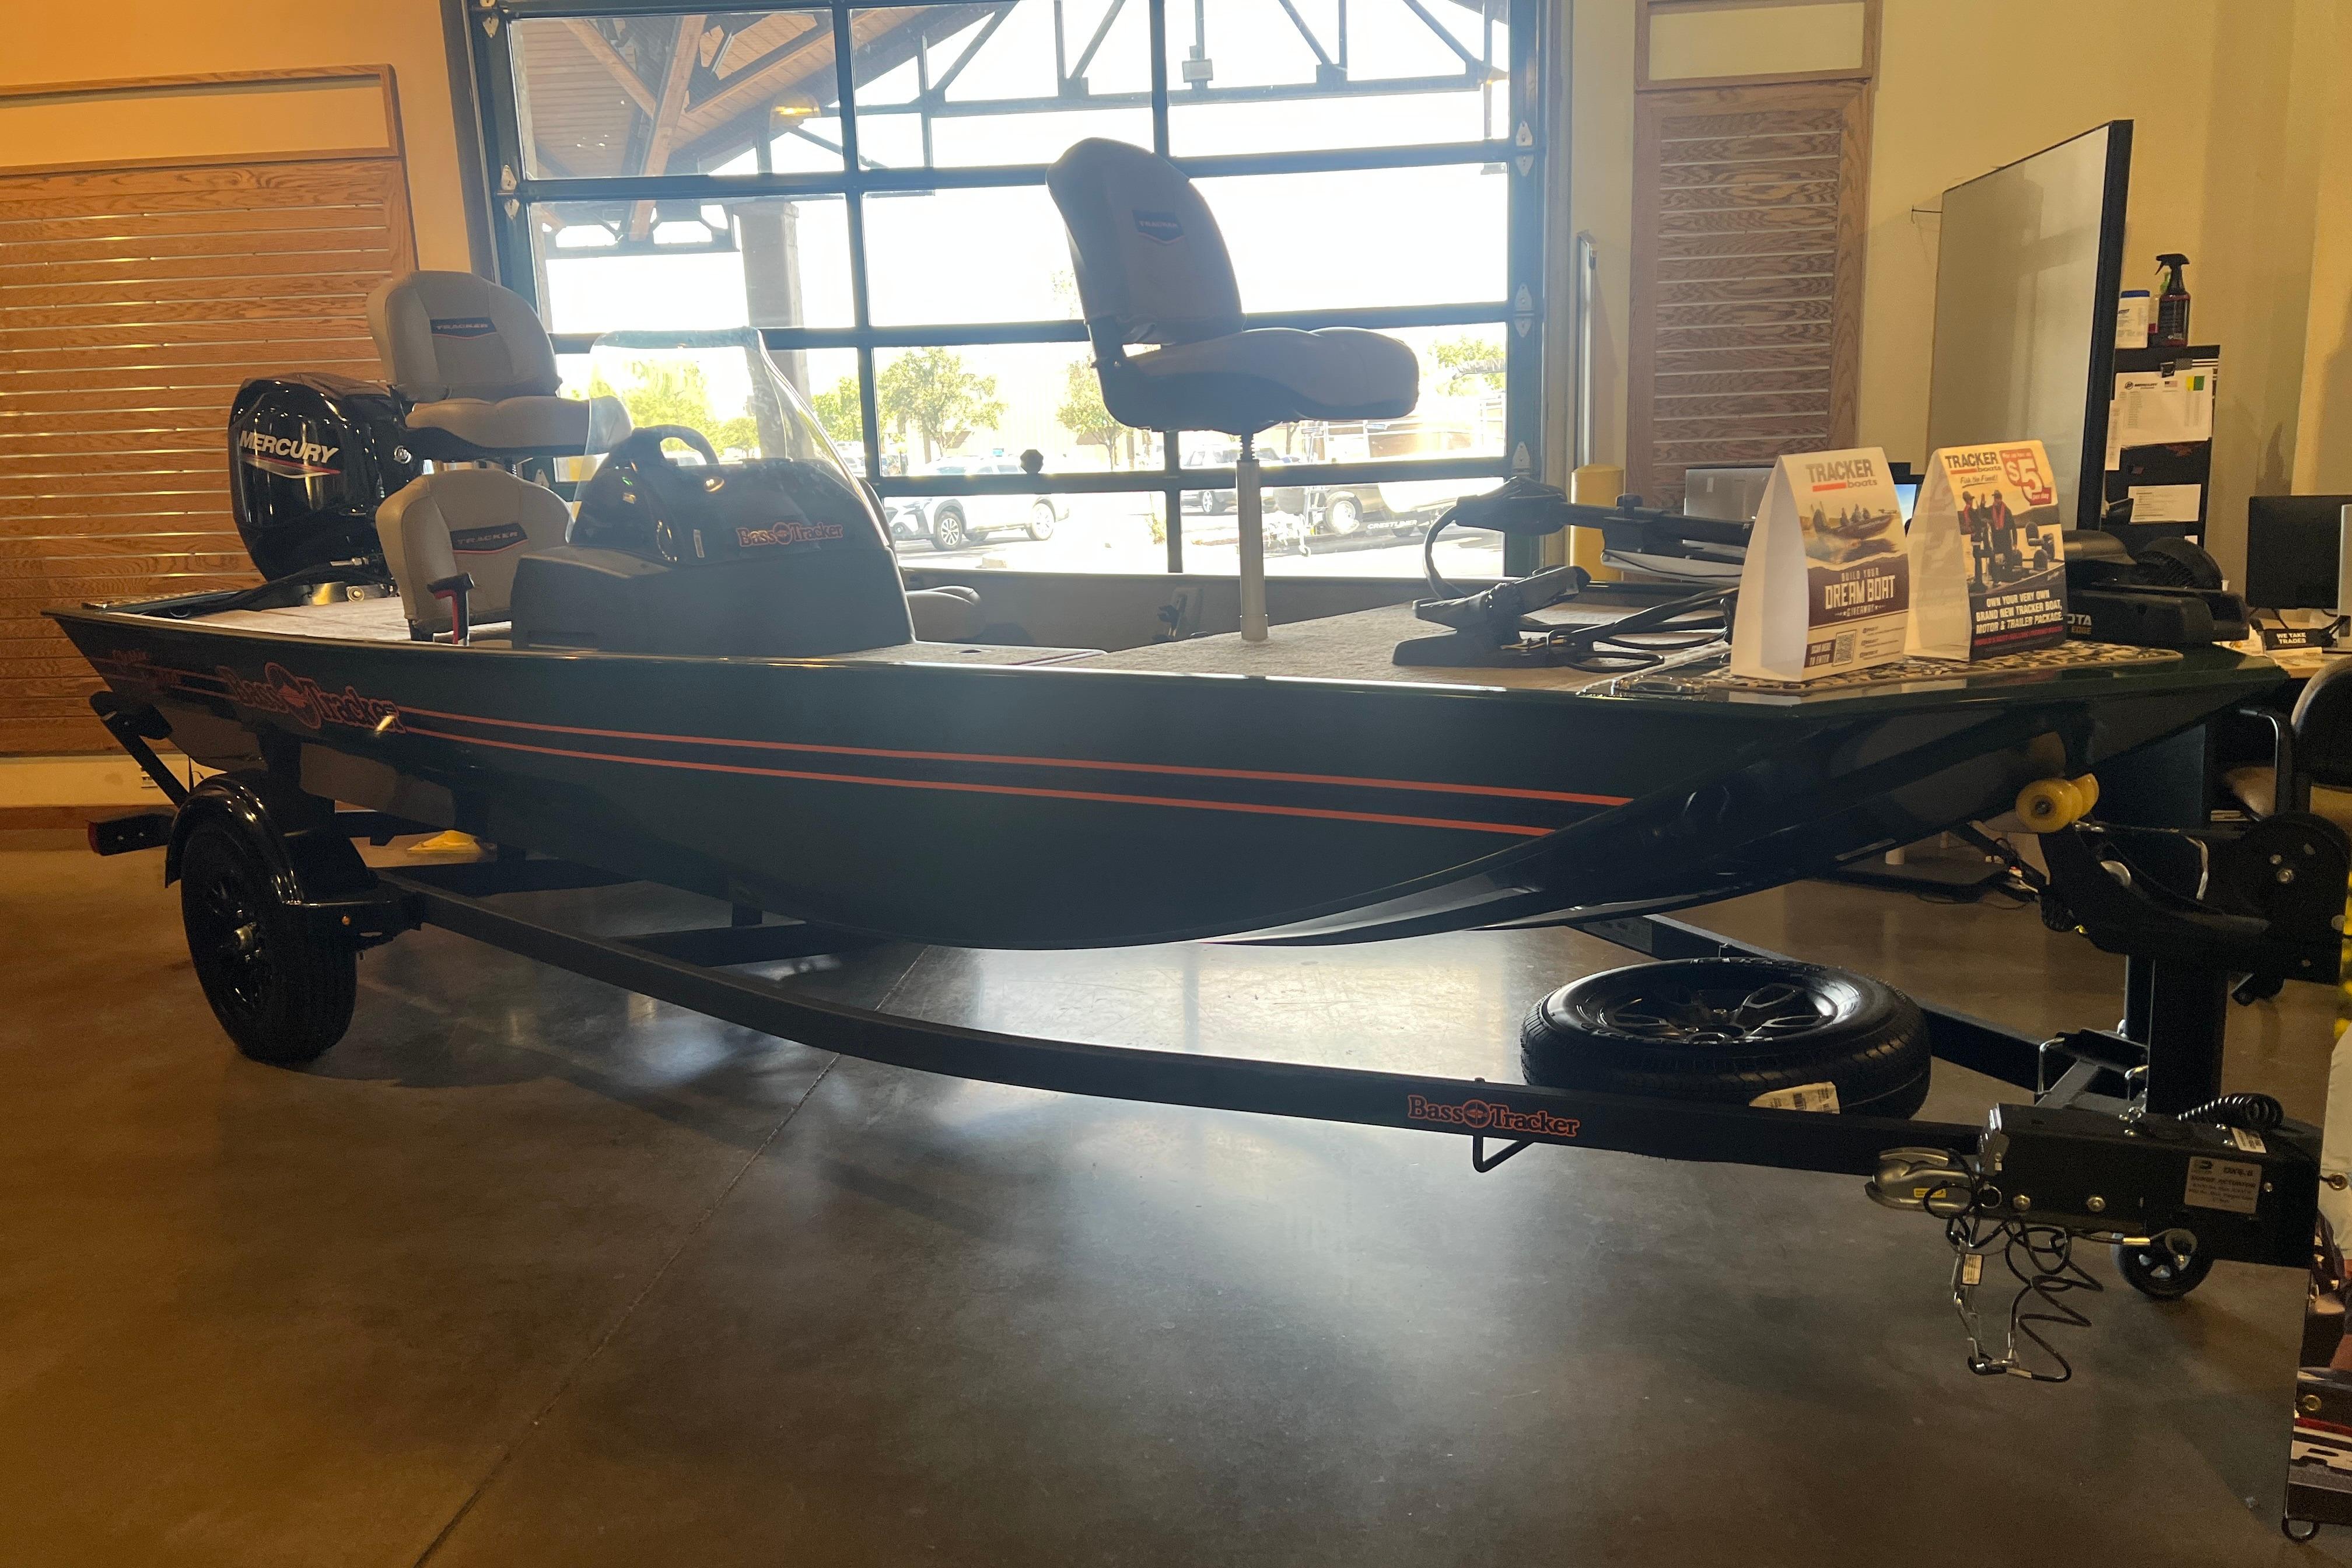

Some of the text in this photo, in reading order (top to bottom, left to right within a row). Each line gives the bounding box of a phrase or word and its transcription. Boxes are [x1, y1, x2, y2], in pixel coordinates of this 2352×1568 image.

[239, 430, 340, 463] MERCURY
[1944, 452, 1999, 468] TRACKER
[1806, 459, 1875, 483] TRACKER
[1847, 480, 1878, 488] boats
[736, 522, 844, 547] Bass Tracker
[1367, 519, 1418, 530] CRESTLINER
[457, 531, 518, 545] TRACKER
[1824, 575, 1895, 610] DREAM BOAT
[1986, 589, 2050, 608] OWN YOUR VERY OWN
[1976, 610, 1999, 622] BRAND
[2000, 607, 2014, 618] NEW
[2015, 602, 2044, 615] TRACKER
[1976, 621, 1999, 635] MOTOR
[2000, 620, 2006, 631] &
[2007, 616, 2033, 629] TRAILER
[293, 677, 407, 734] Tracker
[1408, 1094, 1580, 1137] Bass Tracker
